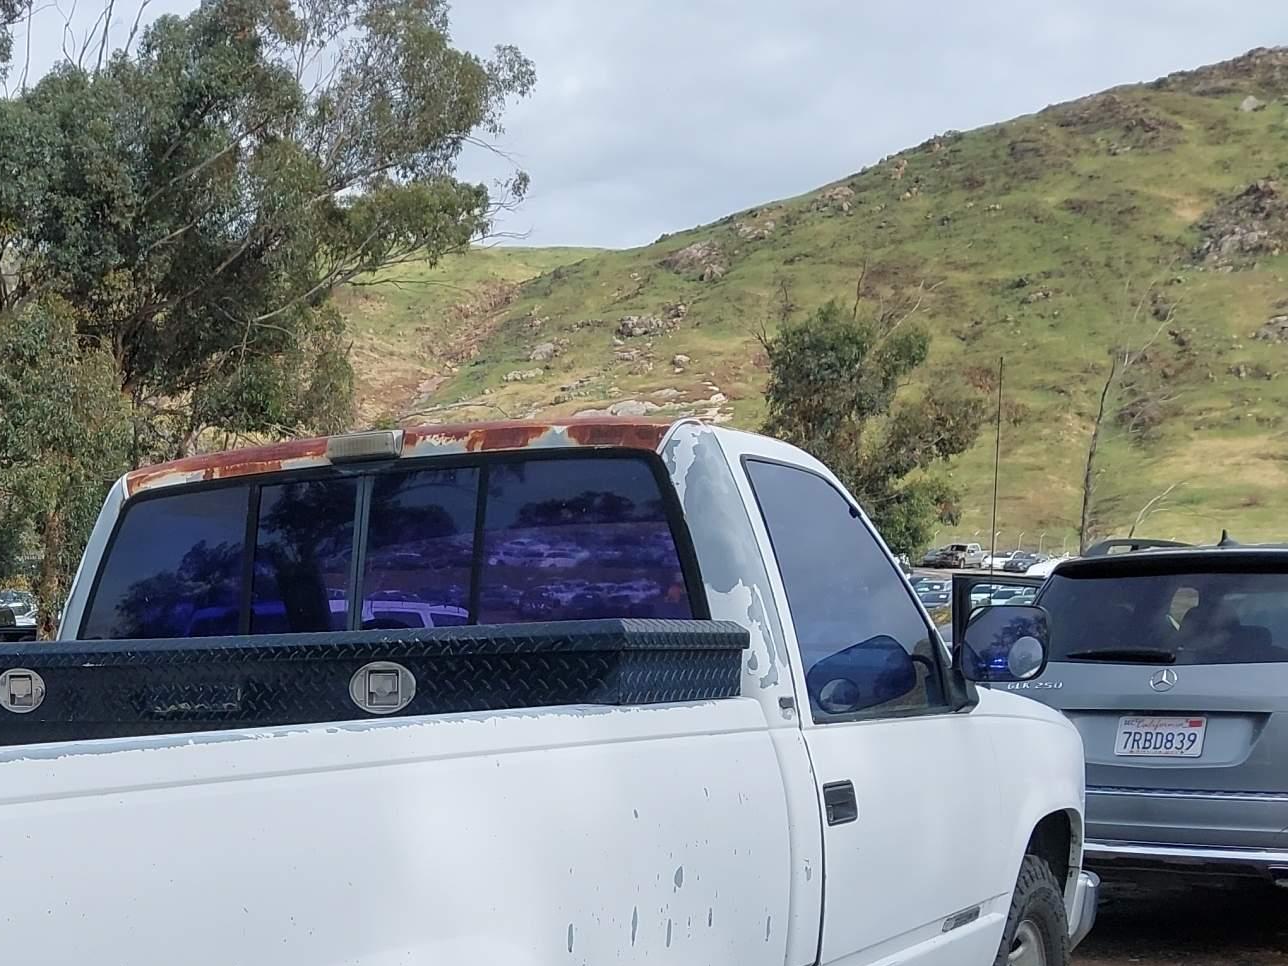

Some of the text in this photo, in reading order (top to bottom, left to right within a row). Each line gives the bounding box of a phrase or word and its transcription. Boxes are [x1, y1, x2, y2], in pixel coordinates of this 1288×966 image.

[1035, 681, 1063, 689] 250
[1136, 719, 1184, 730] California
[1122, 731, 1198, 751] 7RBD839
